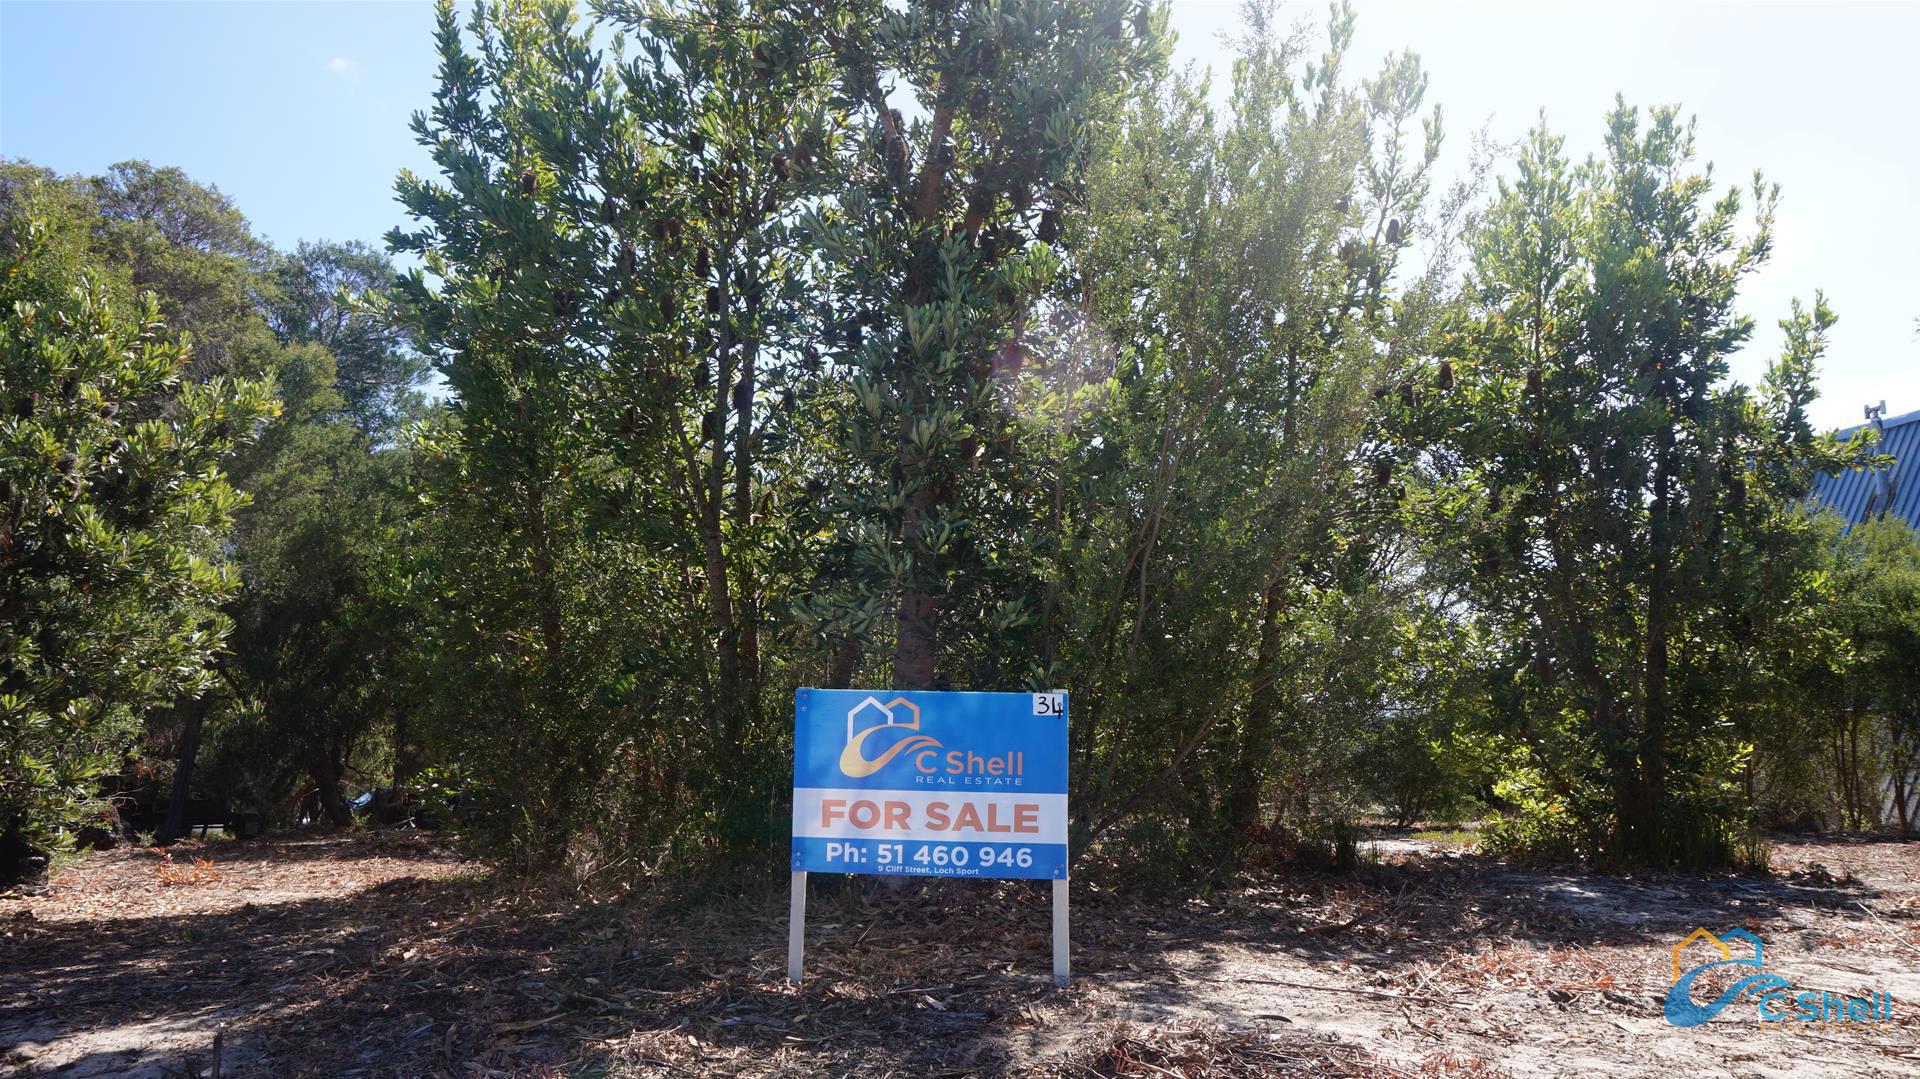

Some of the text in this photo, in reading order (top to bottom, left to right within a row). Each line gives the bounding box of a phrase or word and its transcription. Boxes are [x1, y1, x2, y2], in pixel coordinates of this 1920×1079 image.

[1037, 696, 1064, 719] 34
[916, 750, 1023, 776] C Shell
[916, 776, 1022, 785] REAL ESTATE
[821, 799, 1039, 833] FOR SALE
[826, 842, 1033, 868] Ph: 51 460 946
[885, 865, 903, 873] Cliff
[905, 866, 932, 875] Street,
[934, 867, 954, 875] Loch
[956, 868, 980, 876] Sport
